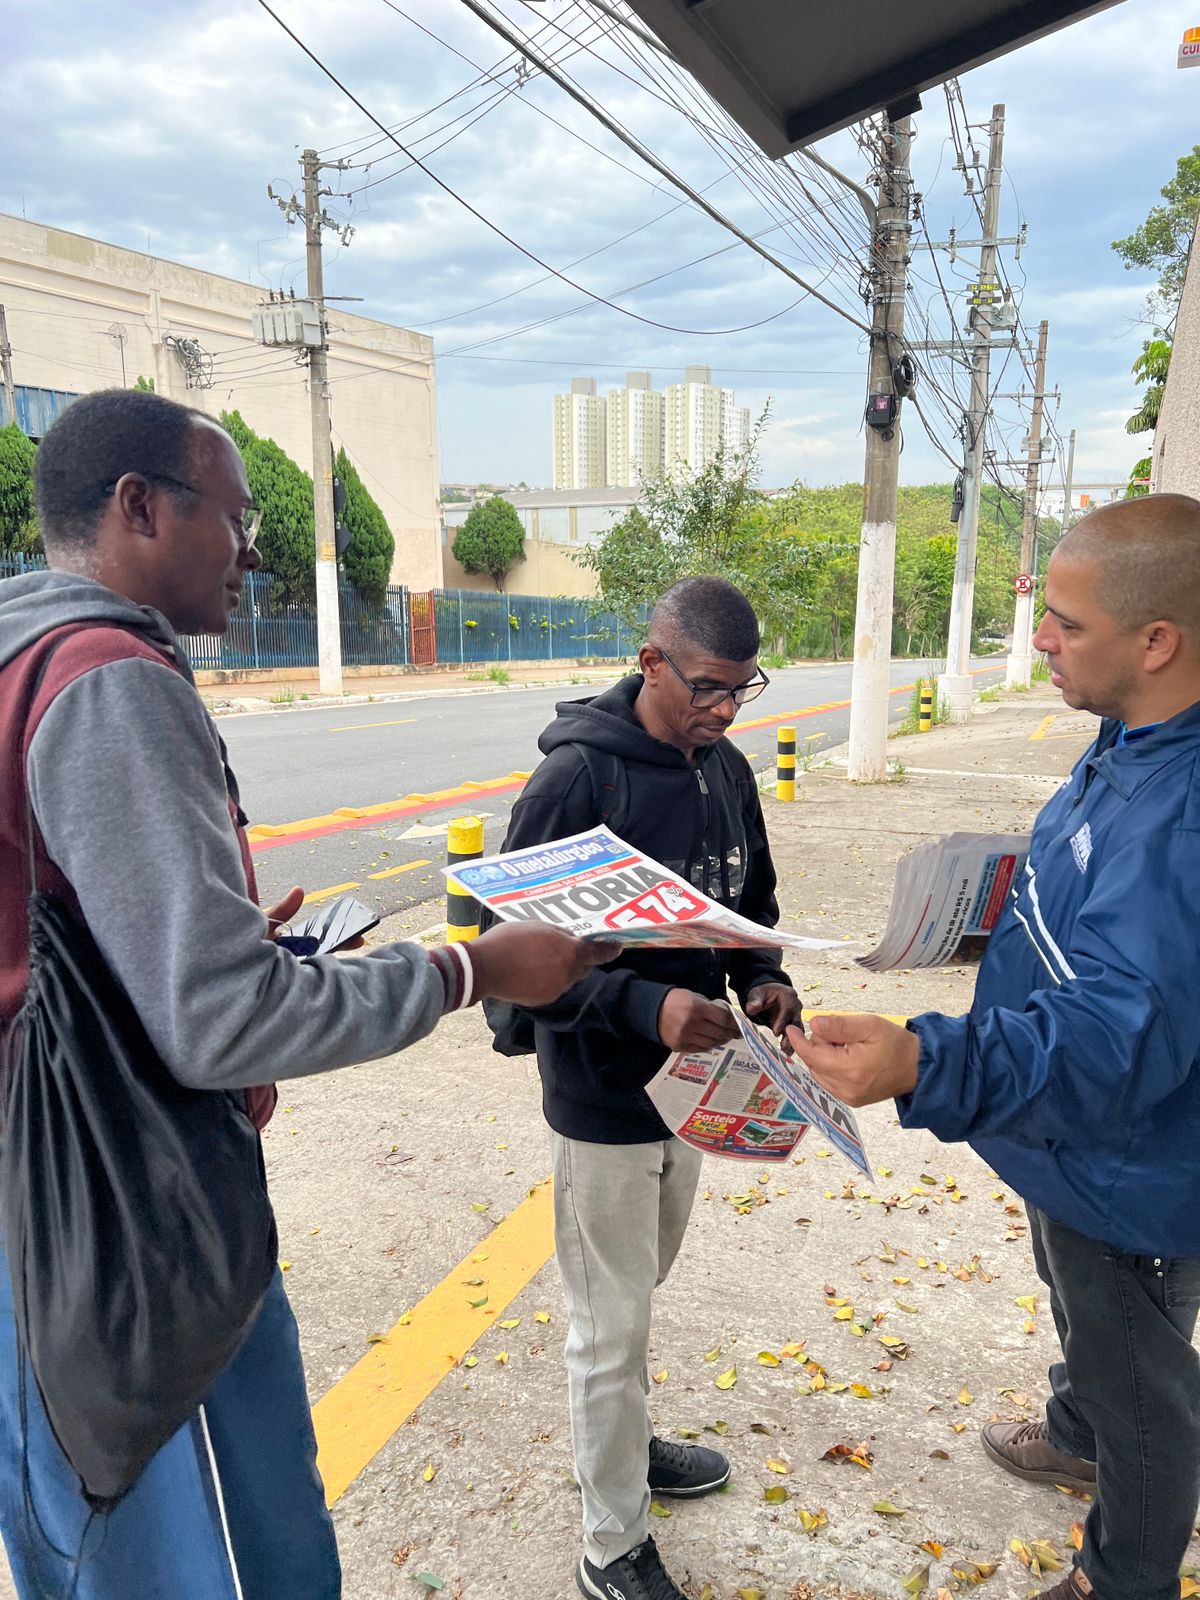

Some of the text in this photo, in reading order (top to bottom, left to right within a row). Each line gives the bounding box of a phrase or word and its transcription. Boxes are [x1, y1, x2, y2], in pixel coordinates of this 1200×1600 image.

[498, 866, 677, 924] VITÓRIA
[524, 882, 563, 896] CAMPANHA
[564, 872, 596, 887] SALARIAL
[692, 1111, 736, 1124] Sorteio
